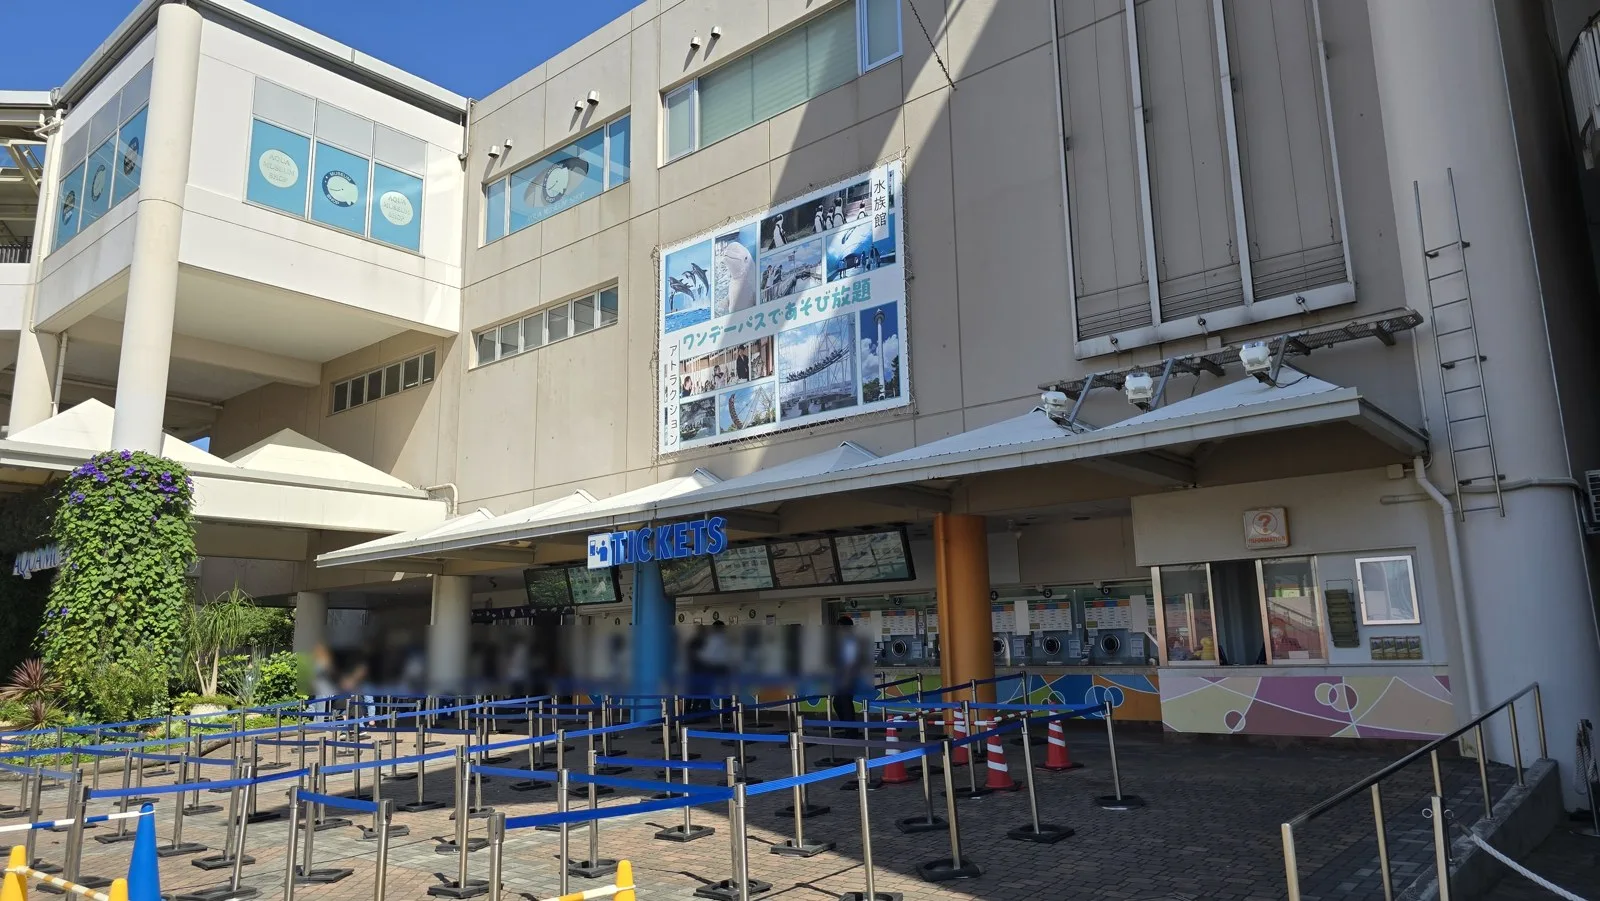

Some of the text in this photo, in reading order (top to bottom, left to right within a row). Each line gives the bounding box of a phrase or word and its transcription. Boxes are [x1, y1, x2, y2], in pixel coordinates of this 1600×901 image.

[269, 154, 290, 166] AQUA
[329, 171, 352, 182] MUSEUM
[388, 196, 406, 206] AQUA
[873, 179, 887, 228] 水族館
[683, 278, 872, 350] ワンデーパスであそび放題
[669, 345, 678, 446] アトラクション
[612, 517, 725, 566] TICKETS
[1248, 536, 1288, 544] INFORMATION
